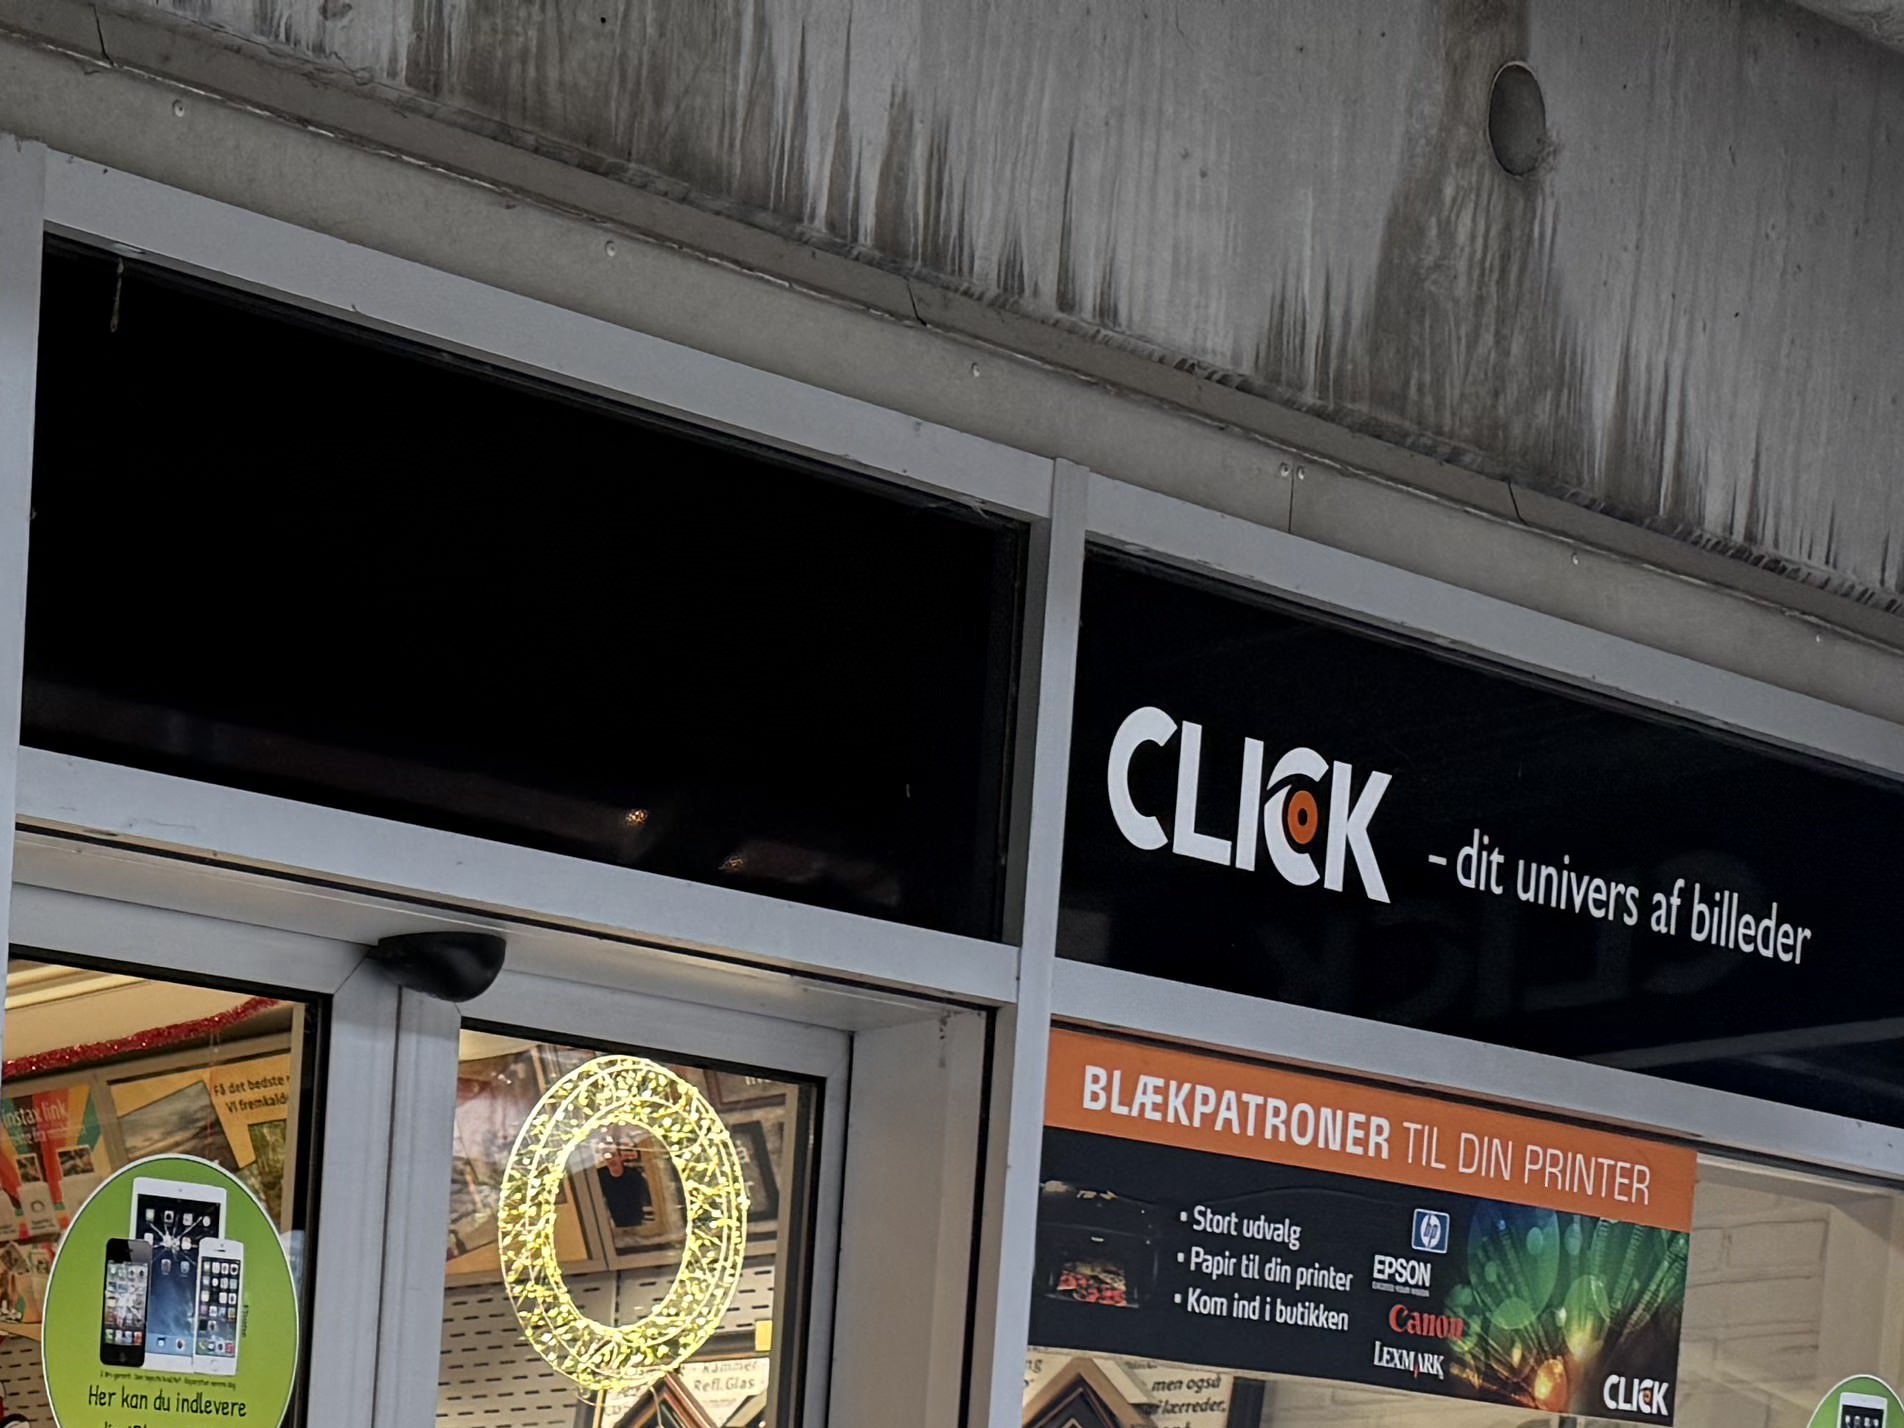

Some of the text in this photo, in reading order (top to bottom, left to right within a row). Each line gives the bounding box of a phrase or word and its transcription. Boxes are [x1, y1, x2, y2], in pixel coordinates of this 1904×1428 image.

[1107, 706, 1393, 904] CLICK
[1456, 829, 1812, 965] dit univers af billeder
[1083, 1063, 1652, 1206] BLÆKPATRONER TIL DIN PRINTER
[1193, 1206, 1302, 1251] Stort udvalg
[1190, 1247, 1235, 1280] Papir
[1241, 1253, 1259, 1279] til
[1264, 1254, 1292, 1283] din
[1296, 1262, 1353, 1295] printer
[1373, 1254, 1432, 1289] EPSON
[1187, 1287, 1350, 1332] Kom ind butikken
[1388, 1303, 1463, 1341] Canon
[1152, 1371, 1222, 1392] men også
[1373, 1340, 1445, 1383] LEXMARK
[88, 1384, 247, 1418] Her kan du indlevere
[1602, 1373, 1669, 1417] CLICK
